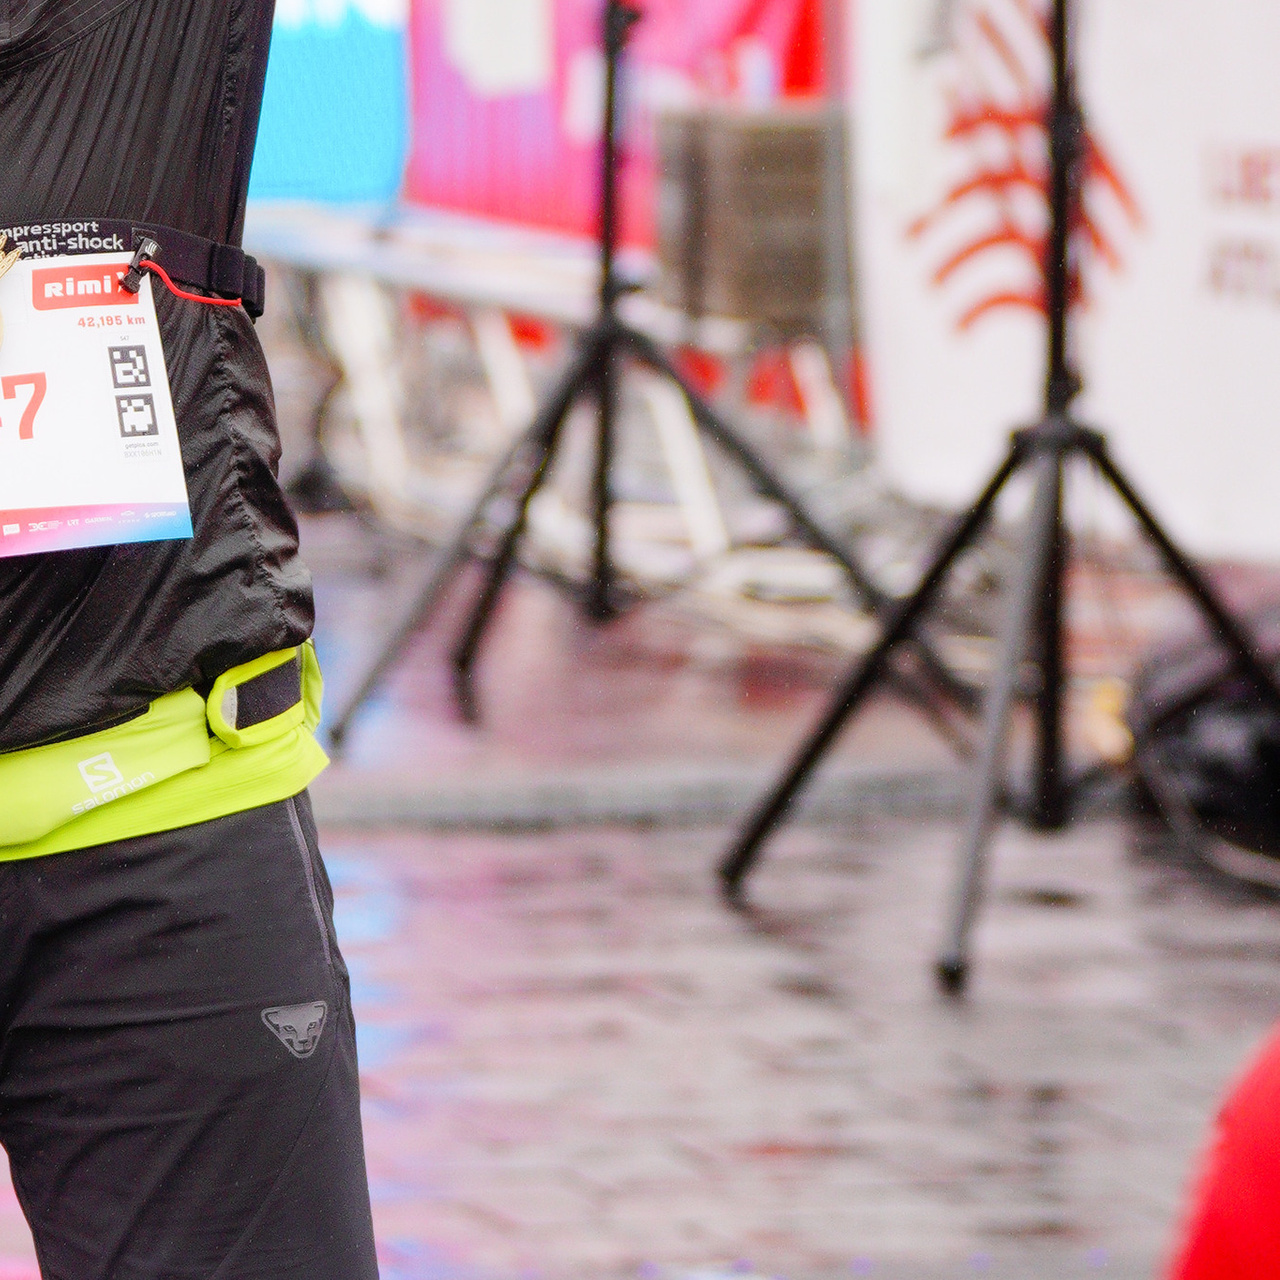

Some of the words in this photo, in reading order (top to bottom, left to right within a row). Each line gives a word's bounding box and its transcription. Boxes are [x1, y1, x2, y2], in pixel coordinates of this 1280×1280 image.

[16, 234, 123, 254] anti-shock
[78, 315, 122, 328] 42,195
[127, 315, 146, 325] km
